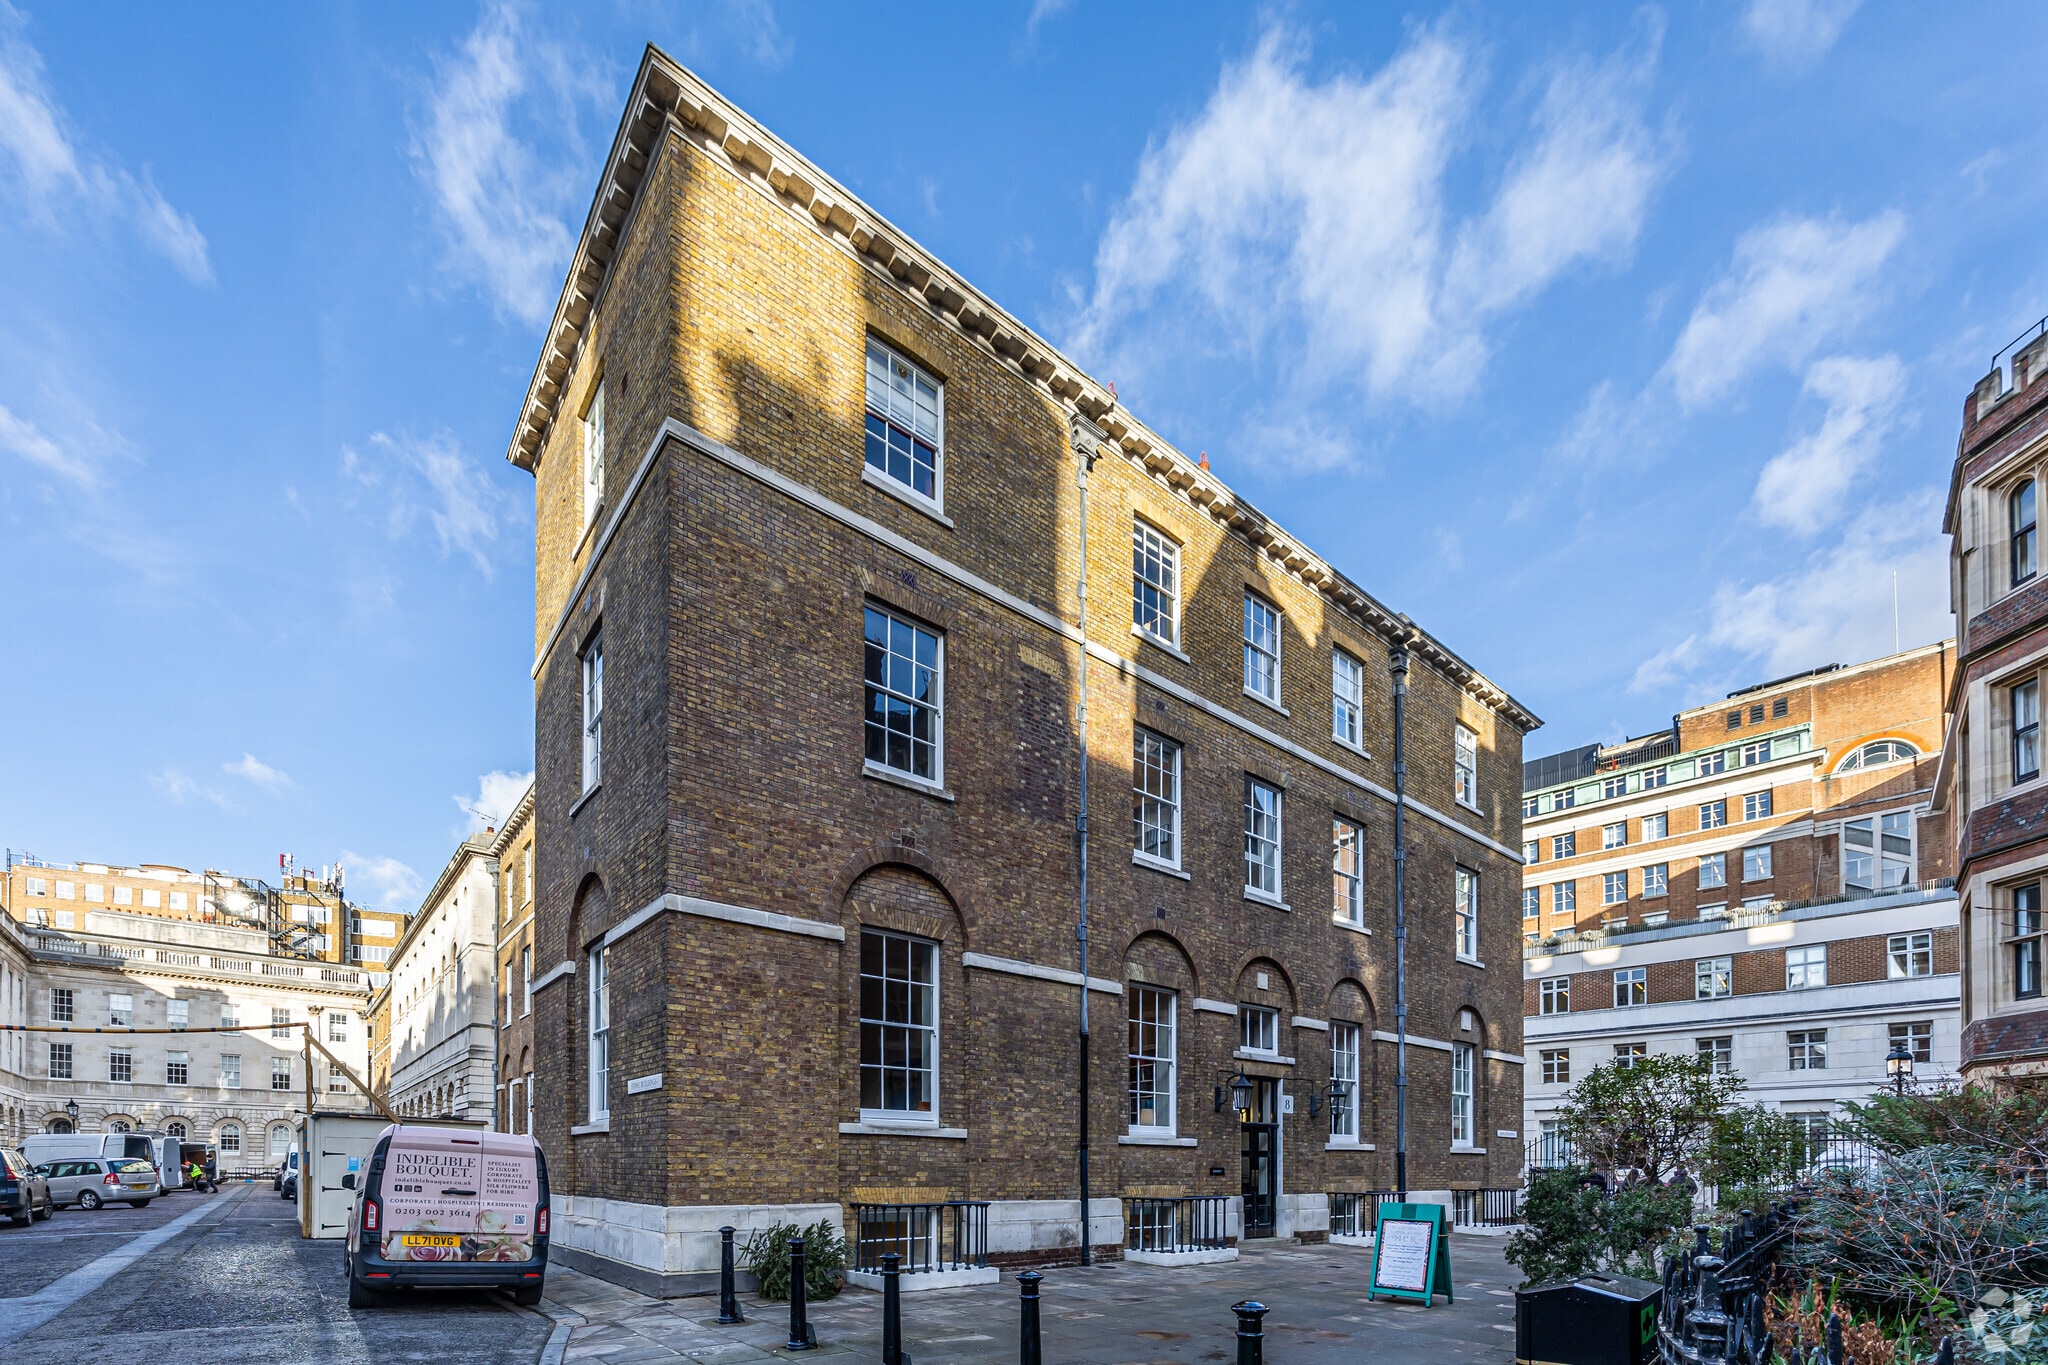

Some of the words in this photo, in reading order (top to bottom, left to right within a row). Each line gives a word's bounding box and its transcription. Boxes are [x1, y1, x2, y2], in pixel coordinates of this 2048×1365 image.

[1285, 1099, 1290, 1109] 8
[396, 1153, 476, 1168] INDELIBLE
[396, 1164, 473, 1178] BOUQUET.
[394, 1177, 472, 1186] indeliblebouquet.co.uk
[395, 1208, 421, 1216] 0203
[449, 1209, 471, 1218] 3614
[407, 1236, 431, 1245] LL71
[433, 1236, 454, 1245] OVG
